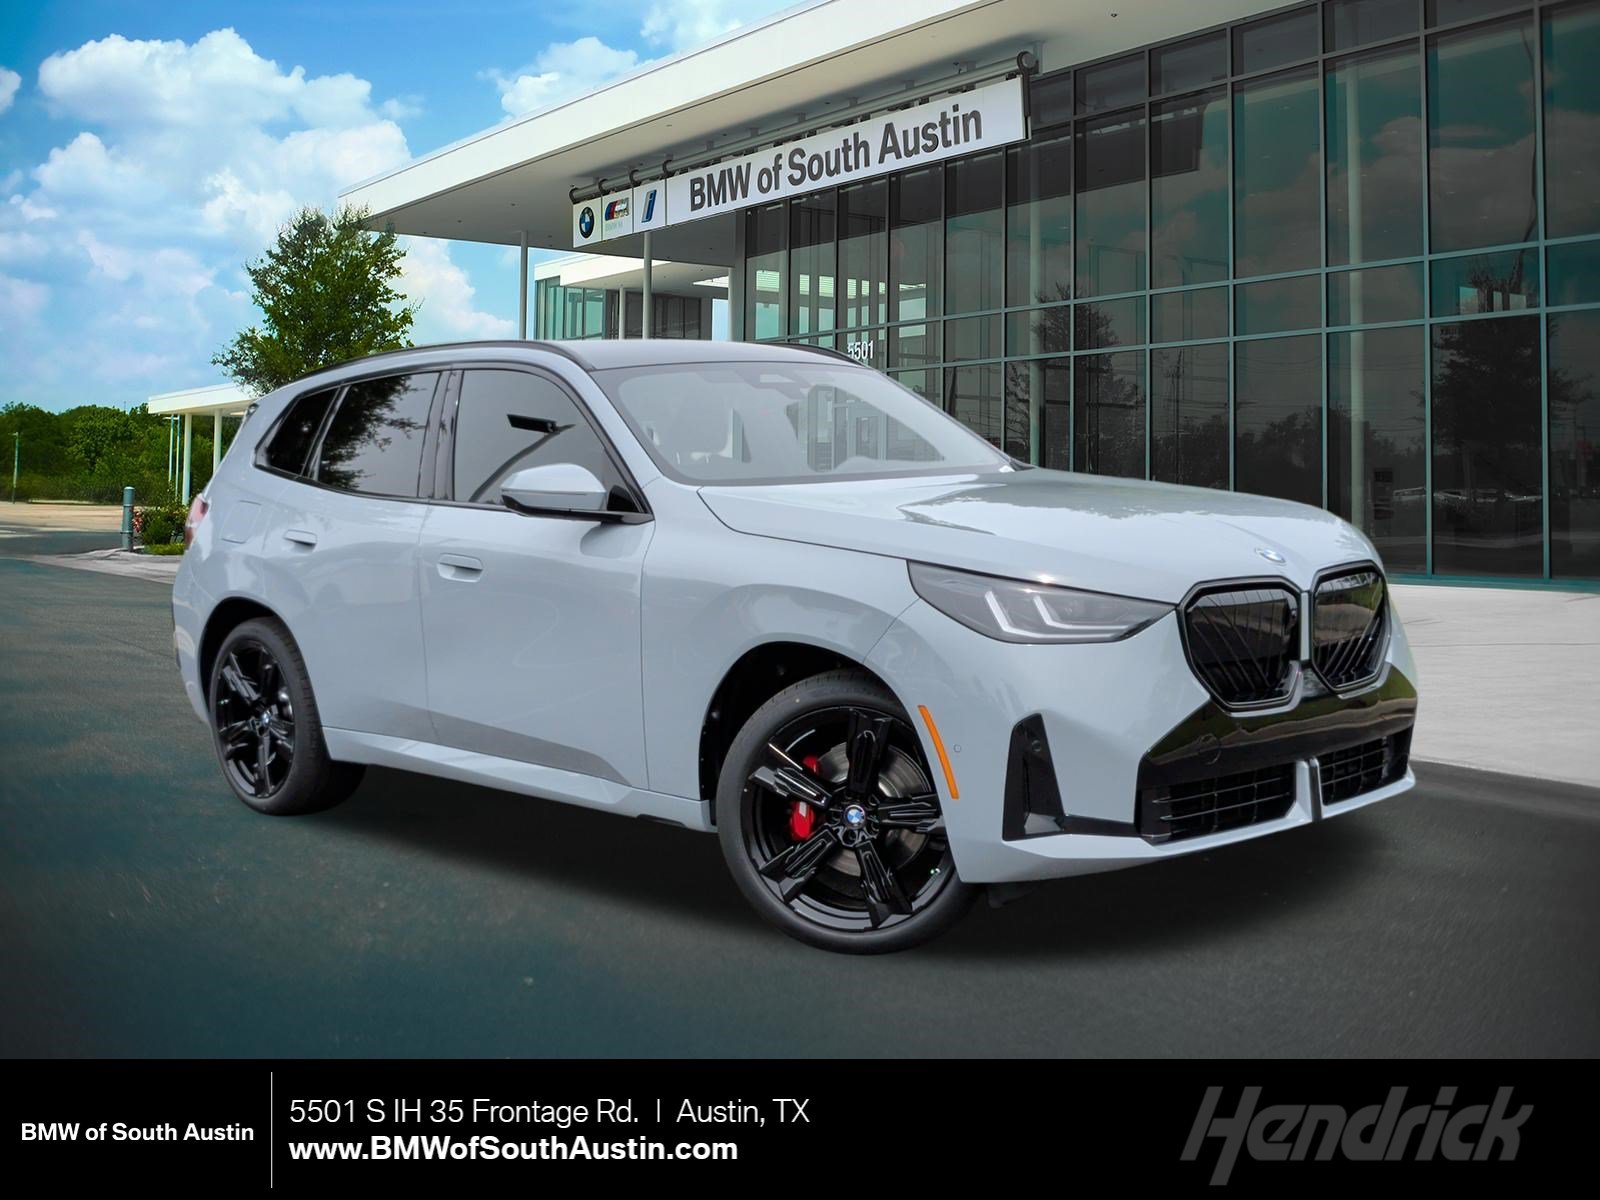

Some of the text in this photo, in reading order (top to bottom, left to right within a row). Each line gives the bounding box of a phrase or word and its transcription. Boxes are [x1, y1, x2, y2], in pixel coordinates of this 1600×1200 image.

[690, 162, 752, 212] BMW
[757, 153, 783, 194] of
[787, 132, 870, 186] South
[878, 104, 982, 164] Austin
[847, 340, 874, 360] 5501
